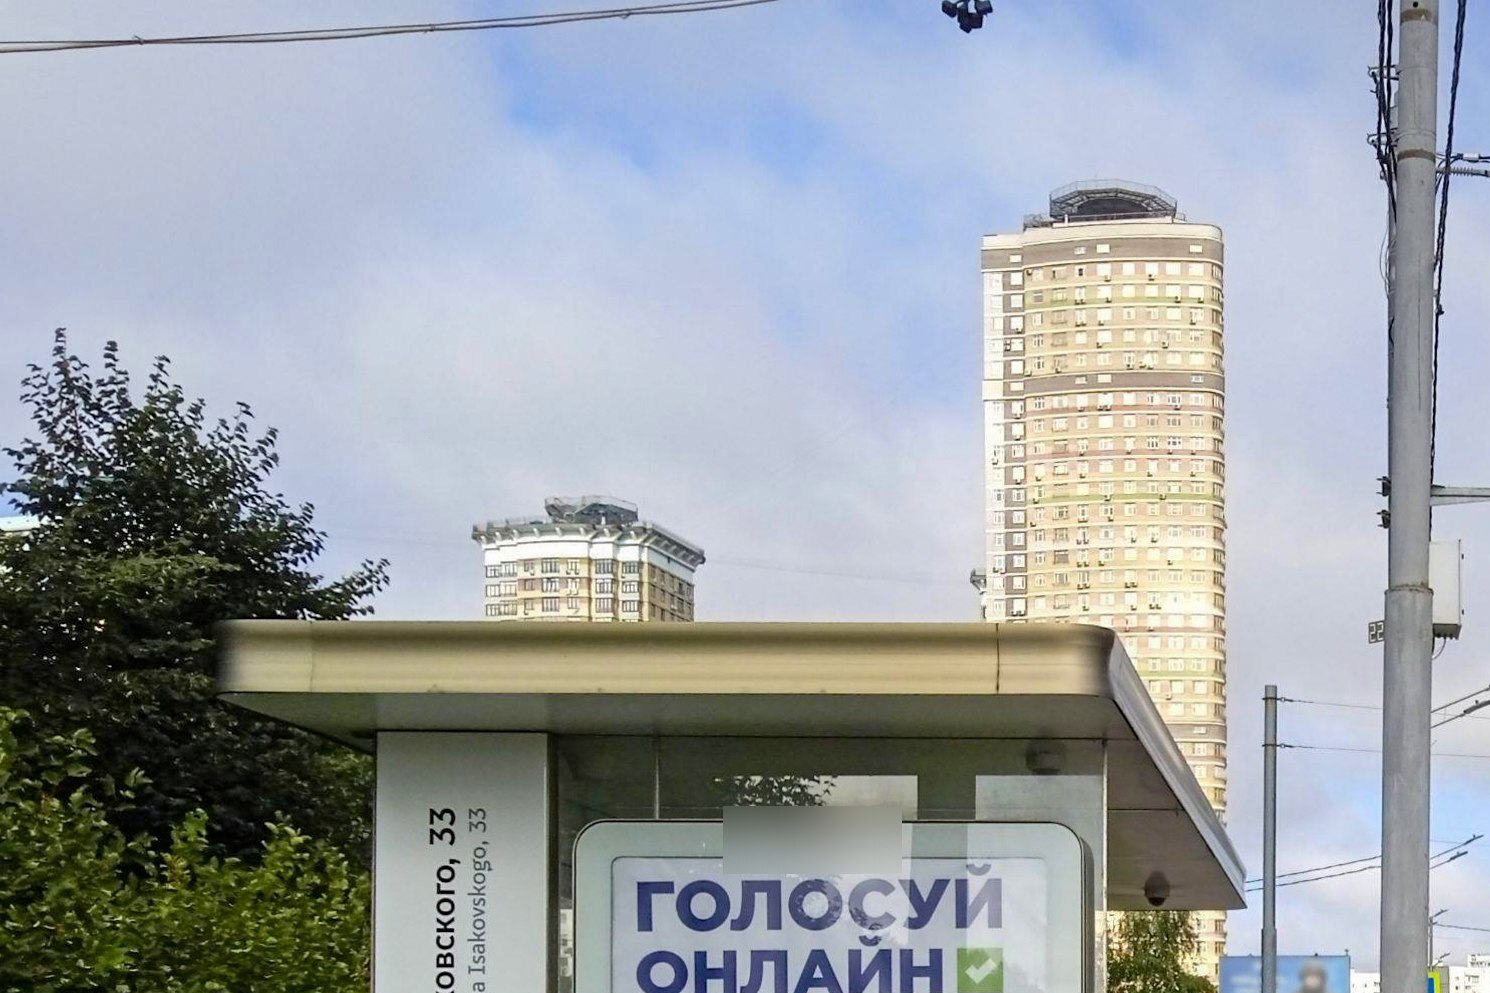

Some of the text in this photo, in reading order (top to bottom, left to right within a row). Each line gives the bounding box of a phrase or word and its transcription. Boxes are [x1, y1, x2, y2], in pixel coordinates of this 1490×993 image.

[429, 808, 456, 846] 33
[468, 808, 487, 832] 33
[467, 841, 492, 975] Isakovskogo,
[637, 864, 1003, 932] ГОЛОСУЙ
